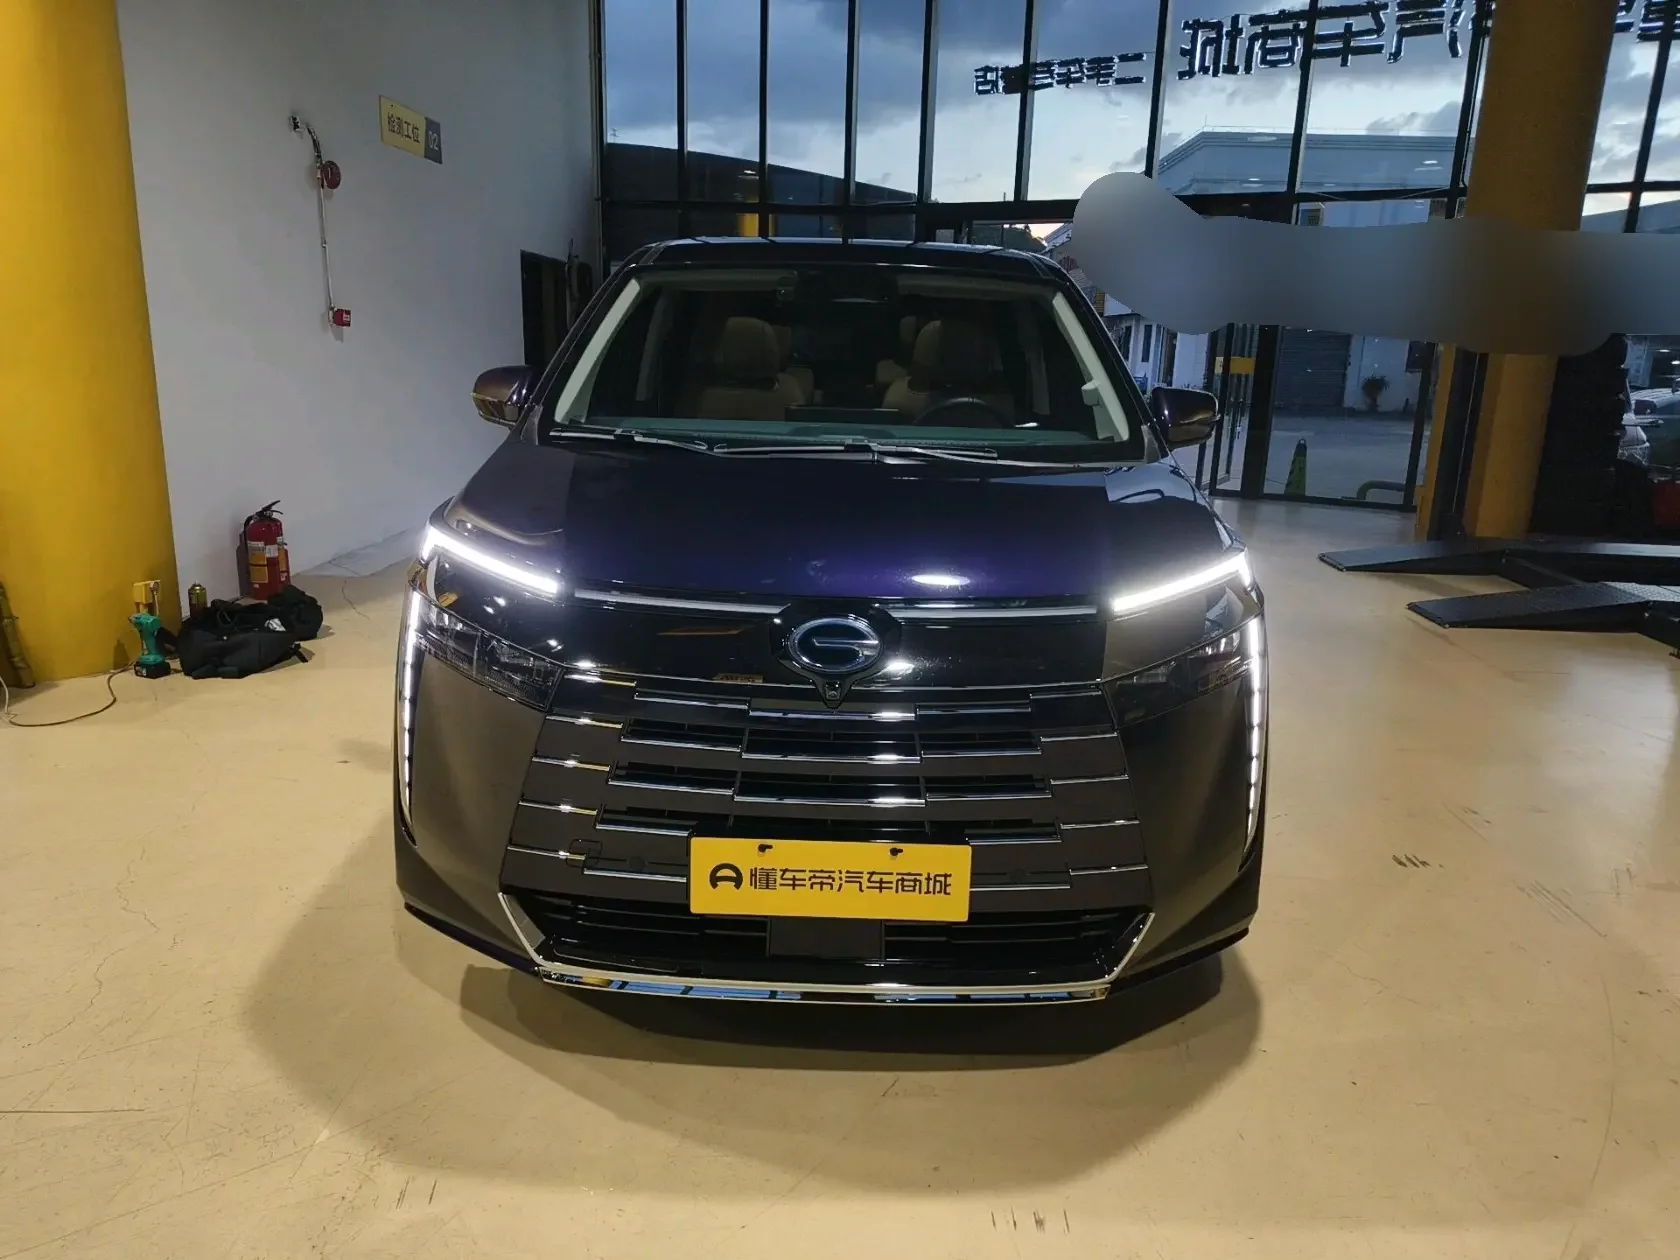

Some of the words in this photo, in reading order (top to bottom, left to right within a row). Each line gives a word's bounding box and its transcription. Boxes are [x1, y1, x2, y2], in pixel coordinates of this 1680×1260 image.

[387, 111, 421, 144] 检测工位
[428, 130, 440, 151] 02
[750, 867, 952, 896] 懂车帝汽车商城
